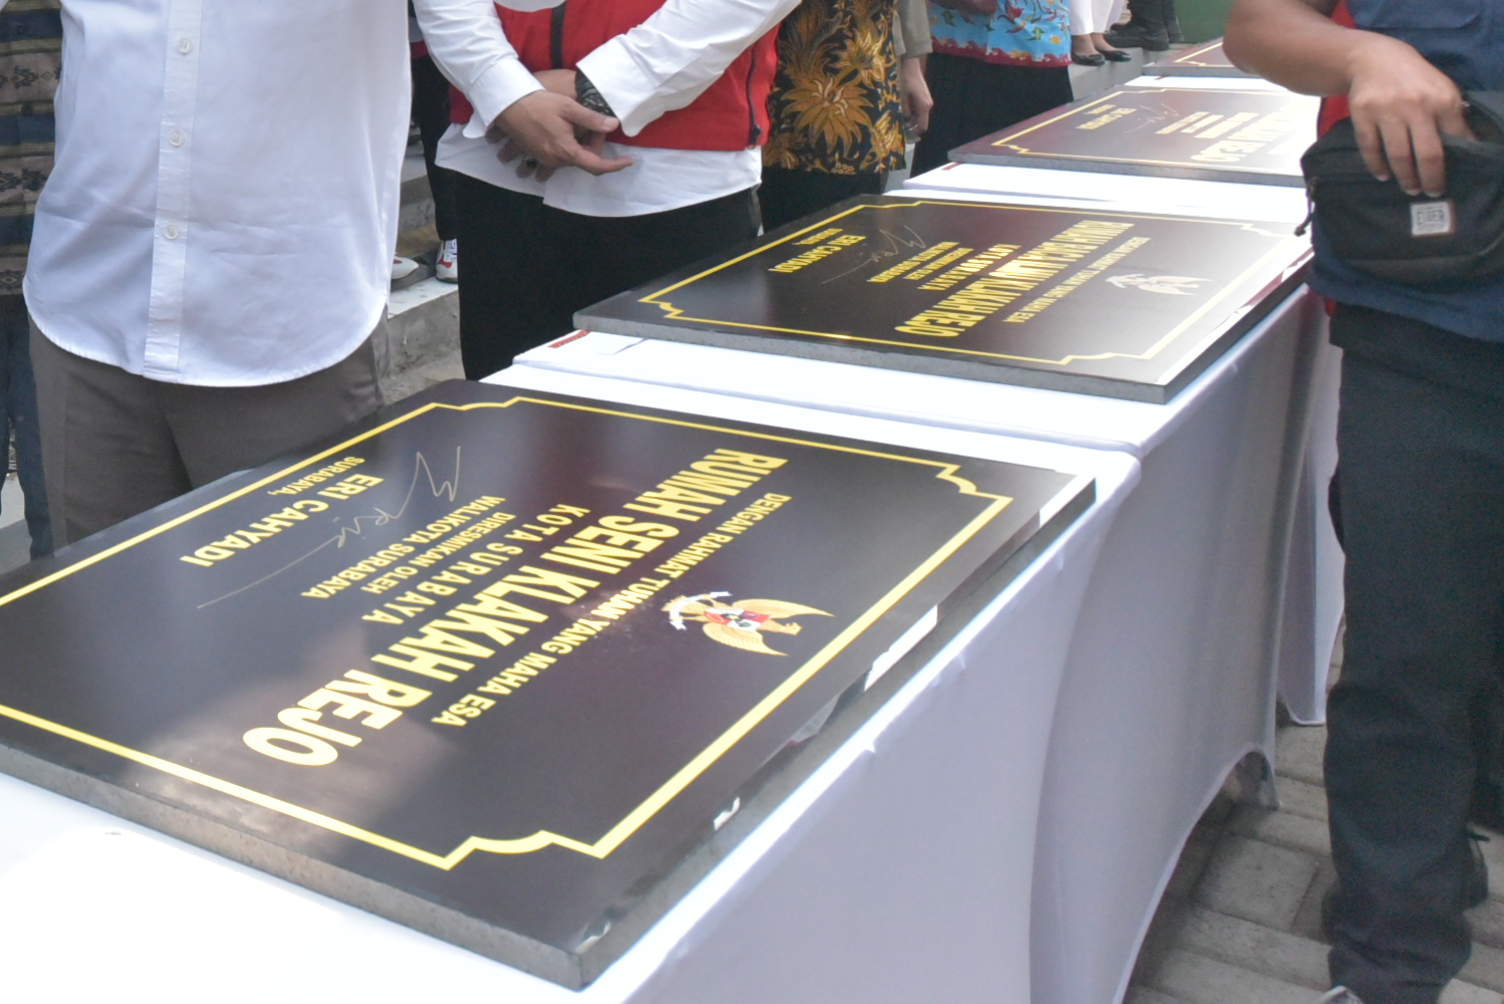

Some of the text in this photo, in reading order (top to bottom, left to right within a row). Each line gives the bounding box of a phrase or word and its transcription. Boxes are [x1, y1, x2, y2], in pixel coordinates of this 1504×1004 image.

[1018, 242, 1098, 261] BACA
[895, 310, 985, 336] REJO
[934, 278, 1038, 313] KLAKAH
[267, 457, 364, 495] SURABAYA,
[624, 449, 787, 521] RUMAH
[180, 474, 383, 566] ERI CAHYADI
[301, 496, 505, 598] WALIKOTA SURABAYA
[361, 512, 515, 593] DIRESMIKAN OLEH
[541, 516, 679, 574] SENI
[362, 504, 590, 624] KOTA SURABAYA
[371, 566, 600, 681] KLAKAH
[432, 493, 791, 726] DENGAN RAHMAT TUHAN YANG MAHA ESA
[243, 669, 431, 766] REJO
